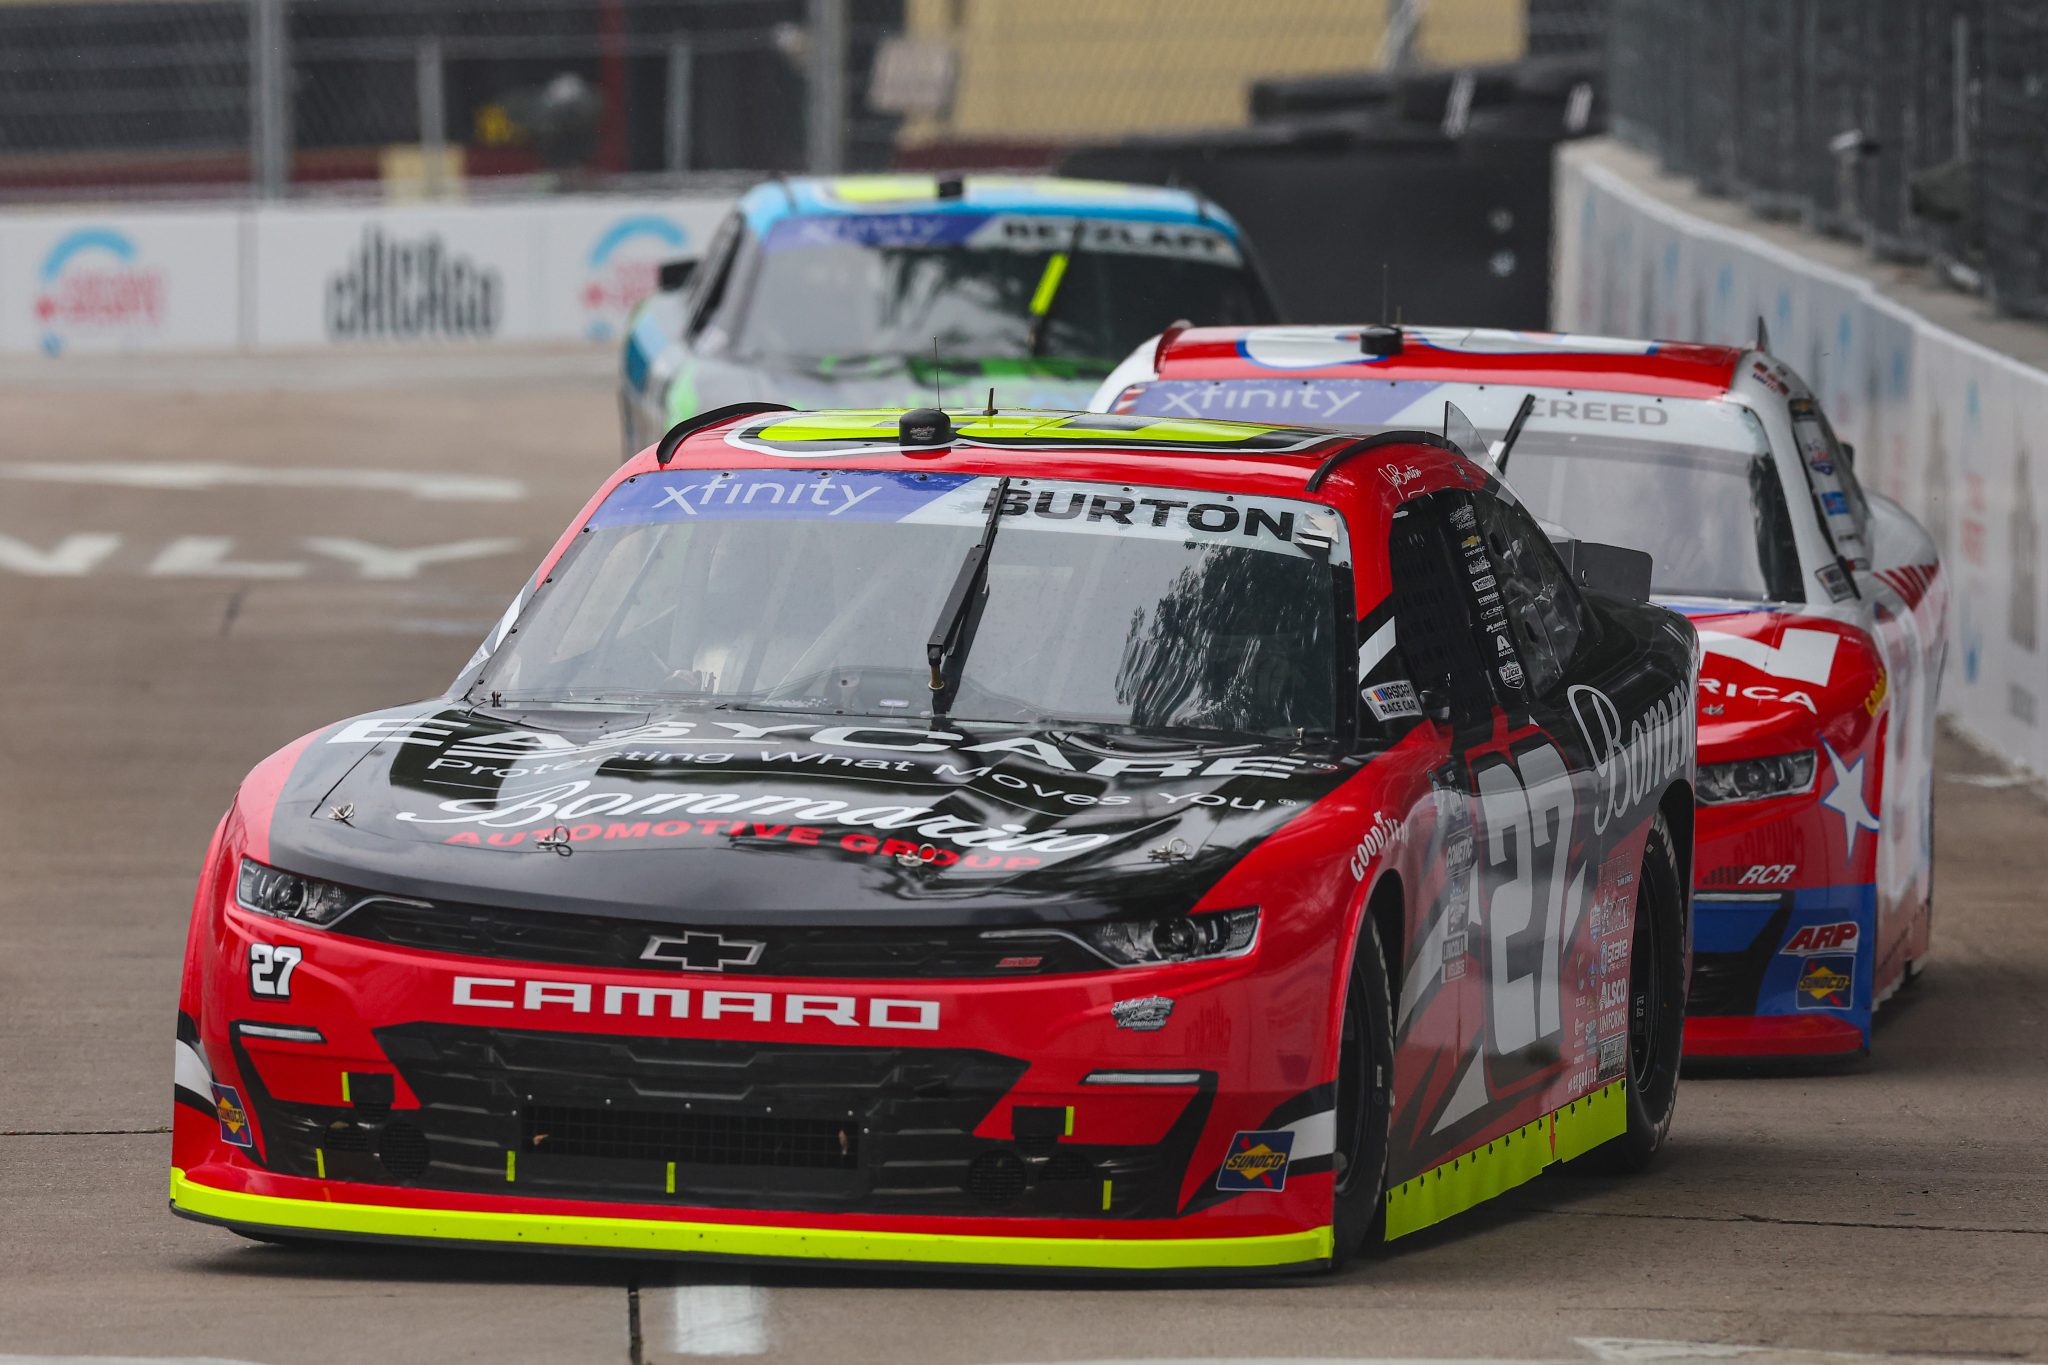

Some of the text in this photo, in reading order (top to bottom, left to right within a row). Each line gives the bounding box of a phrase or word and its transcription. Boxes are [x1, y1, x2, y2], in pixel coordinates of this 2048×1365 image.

[1160, 384, 1361, 418] xfinity
[652, 475, 883, 516] xfinity
[983, 487, 1295, 542] BURTON
[1380, 699, 1417, 715] RACE CAR
[759, 751, 915, 773] What
[933, 763, 1130, 807] Moves
[1159, 792, 1266, 811] You
[445, 819, 1041, 870] AUTOMOTIVE GROUP
[1738, 864, 1797, 885] RCR
[1477, 743, 1576, 1056] 27
[1789, 922, 1858, 951] ARP
[250, 943, 302, 998] 27
[1800, 974, 1850, 992] SUNOCO
[453, 976, 939, 1030] CAMARO
[1228, 1153, 1285, 1169] SUNOCO
